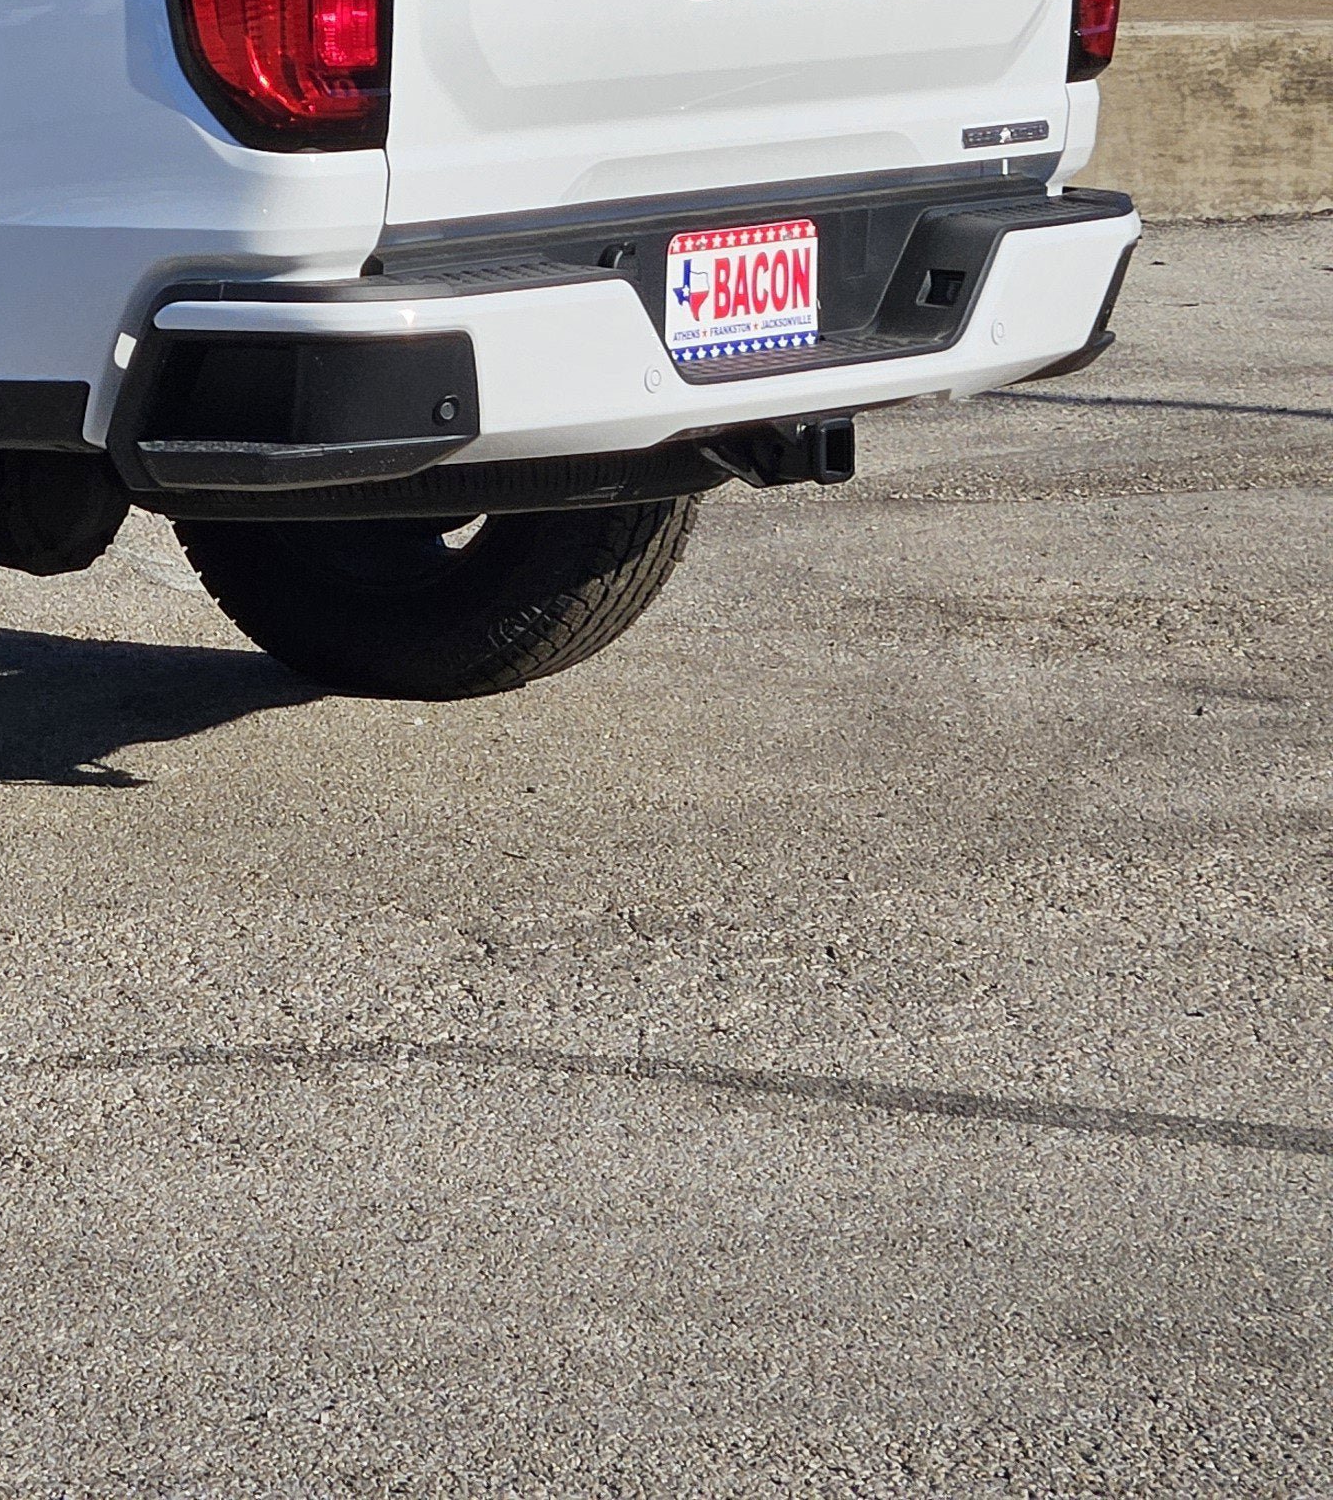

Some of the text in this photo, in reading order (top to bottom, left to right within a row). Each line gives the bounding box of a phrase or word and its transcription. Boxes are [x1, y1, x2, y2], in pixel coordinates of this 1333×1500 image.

[714, 247, 811, 320] BACON
[672, 314, 812, 342] ATHENS FRANKSTON JACKSONVILLE
